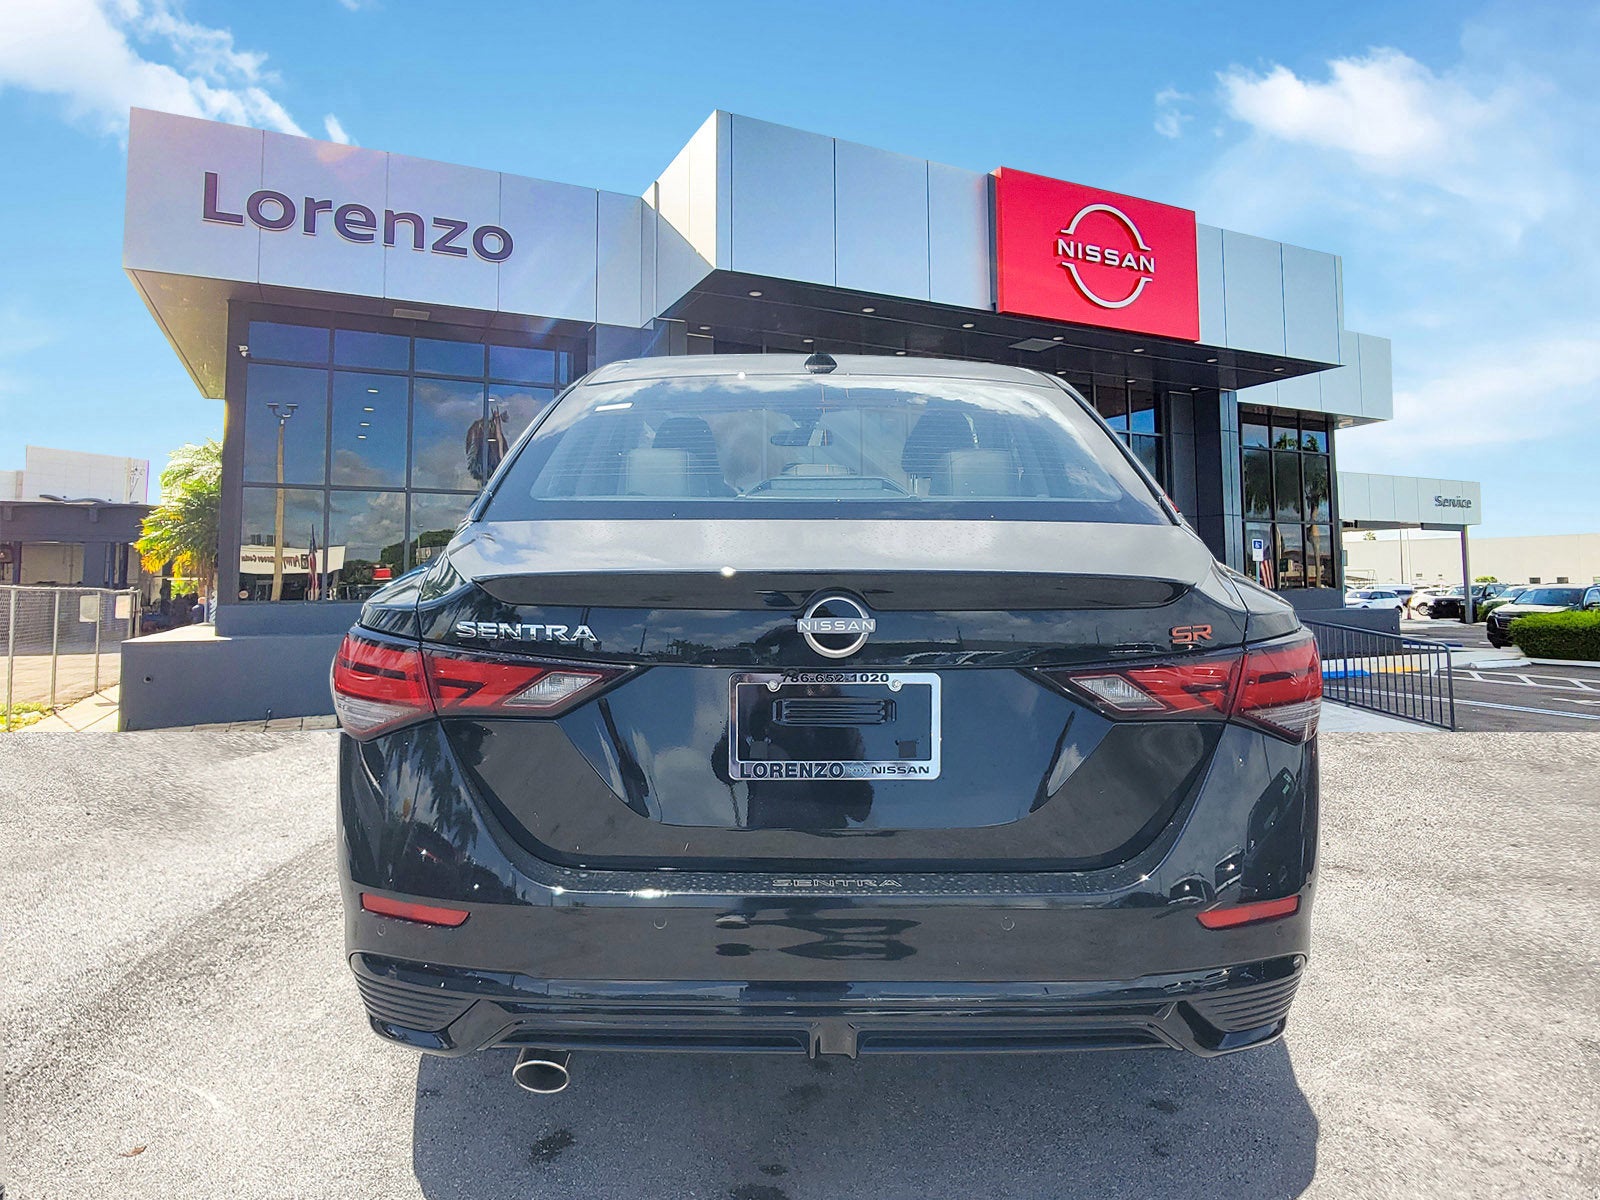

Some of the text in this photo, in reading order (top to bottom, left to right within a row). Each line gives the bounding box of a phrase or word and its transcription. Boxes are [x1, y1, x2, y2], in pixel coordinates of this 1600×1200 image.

[202, 171, 514, 262] Lorenzo
[1057, 238, 1155, 273] NISSAN
[1434, 495, 1472, 508] Service
[456, 621, 598, 643] SENTRA
[799, 619, 875, 632] NISSAN
[1171, 625, 1212, 644] SR
[781, 673, 889, 683] 786-652-1020
[739, 762, 845, 779] LORENZO
[871, 766, 930, 775] NISSAN
[772, 878, 902, 887] SENTRA
